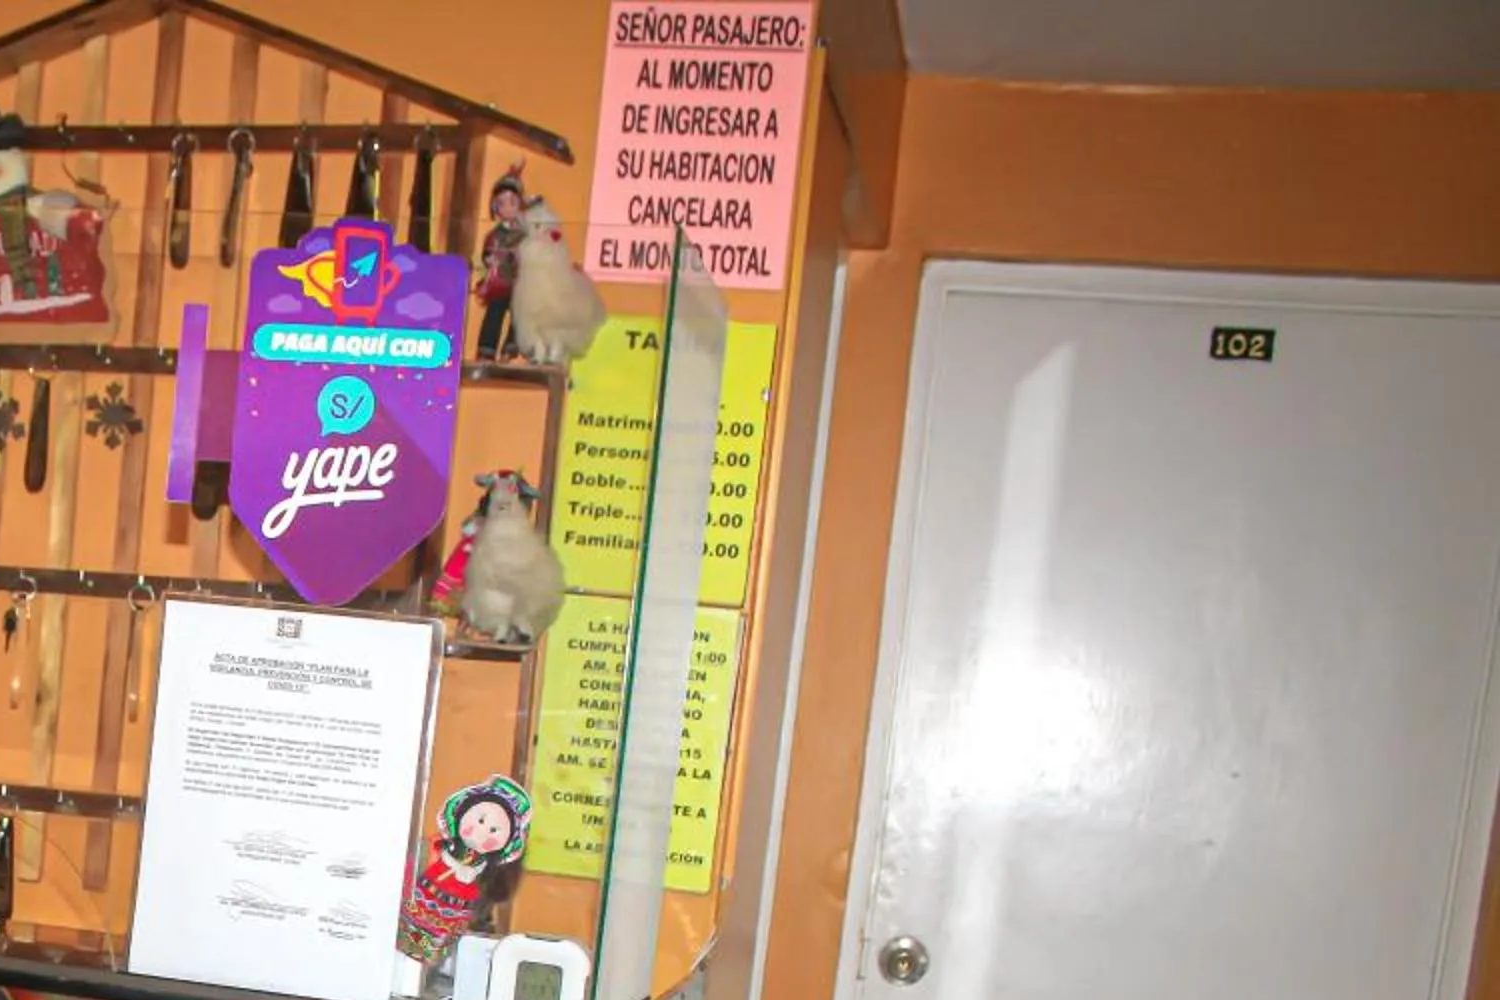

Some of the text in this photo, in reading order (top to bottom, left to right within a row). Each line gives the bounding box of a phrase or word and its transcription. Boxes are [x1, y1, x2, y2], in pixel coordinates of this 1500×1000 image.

[615, 6, 806, 48] SEÑOR PASAJERO:
[637, 59, 774, 92] AL MOMENTO
[621, 104, 779, 138] DE INGRESAR A
[617, 149, 775, 184] SU HABITACION
[628, 195, 752, 229] CANCELARA
[599, 239, 622, 268] EL
[709, 245, 772, 276] TOTAL
[271, 331, 434, 358] PAGA AQUÍ CON
[1215, 332, 1265, 357] 102
[261, 442, 397, 539] yape
[692, 768, 712, 780] LA
